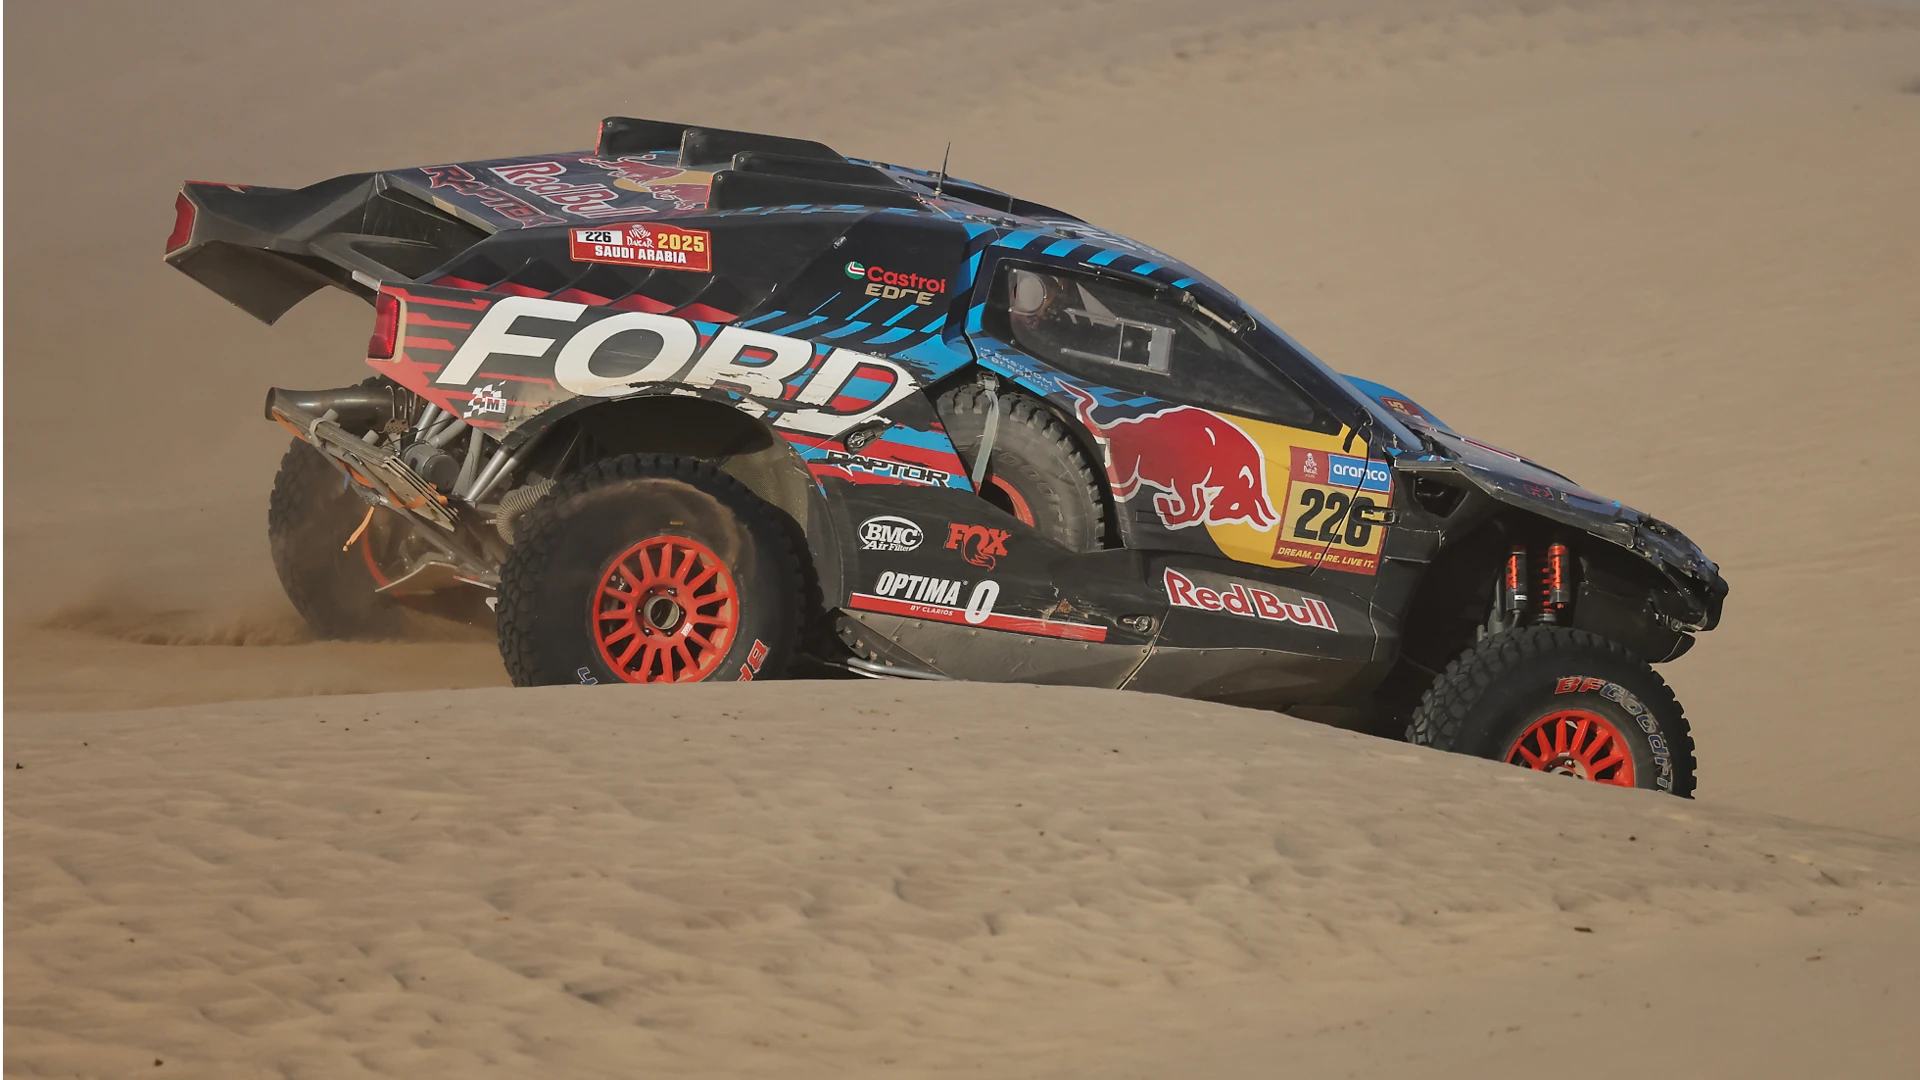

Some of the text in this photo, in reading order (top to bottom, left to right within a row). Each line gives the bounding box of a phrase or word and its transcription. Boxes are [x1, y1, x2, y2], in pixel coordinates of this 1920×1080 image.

[419, 164, 569, 230] RAPTOR
[488, 161, 658, 219] Red Bull
[585, 231, 612, 242] 226
[657, 233, 705, 252] 2025
[595, 245, 687, 264] SAUDI ARABIA
[867, 266, 946, 293] Castrol
[436, 296, 922, 437] FORD
[826, 449, 950, 488] RAPTOR
[1333, 464, 1387, 482] aramco
[1293, 488, 1375, 548] 226
[862, 540, 888, 551] Air
[865, 522, 919, 546] BMC
[946, 523, 1012, 570] FOX
[1277, 547, 1374, 569] DREAM. DARE. LIVE IT.
[875, 570, 961, 606] OPTIMA
[1163, 567, 1339, 633] Red Bull
[922, 606, 954, 617] CLARIOS
